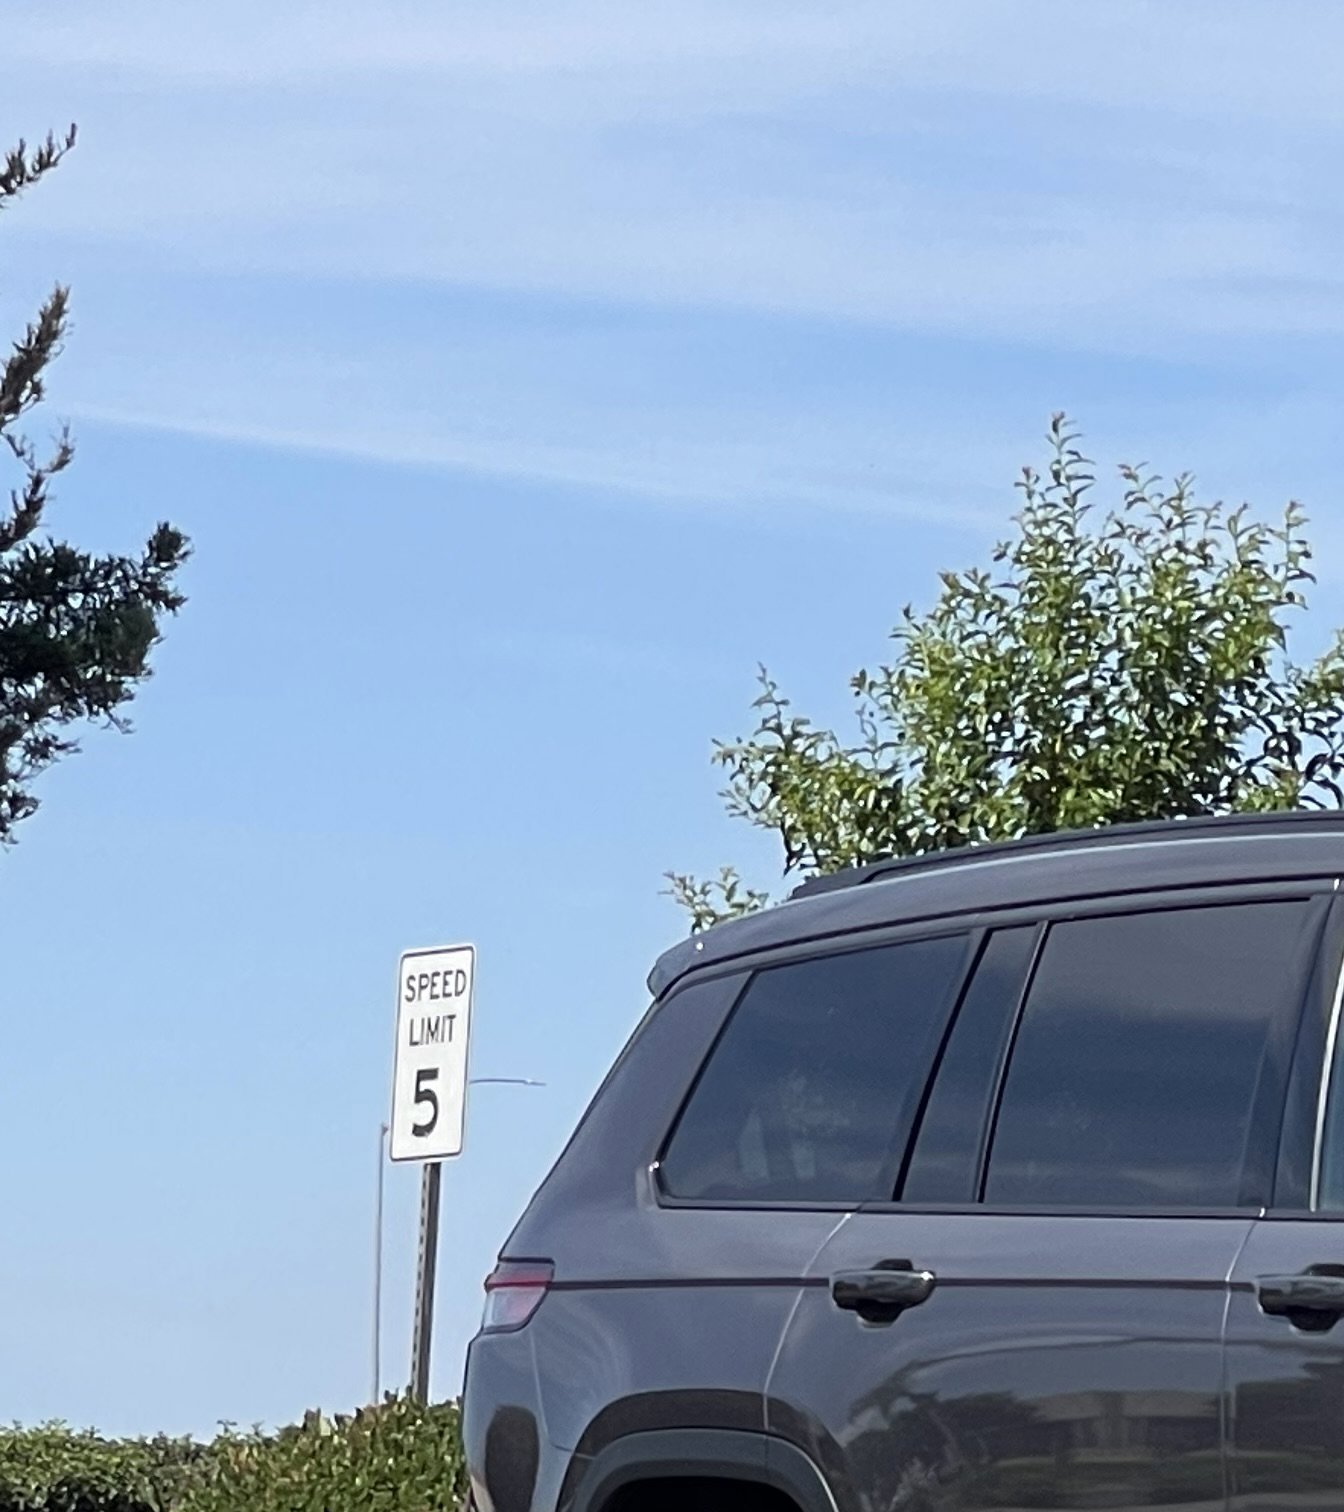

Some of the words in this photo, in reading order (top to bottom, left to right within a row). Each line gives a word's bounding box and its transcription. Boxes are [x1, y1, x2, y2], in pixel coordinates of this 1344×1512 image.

[404, 969, 467, 1002] SPEED
[408, 1014, 457, 1046] LIMIT
[411, 1067, 440, 1137] 5
